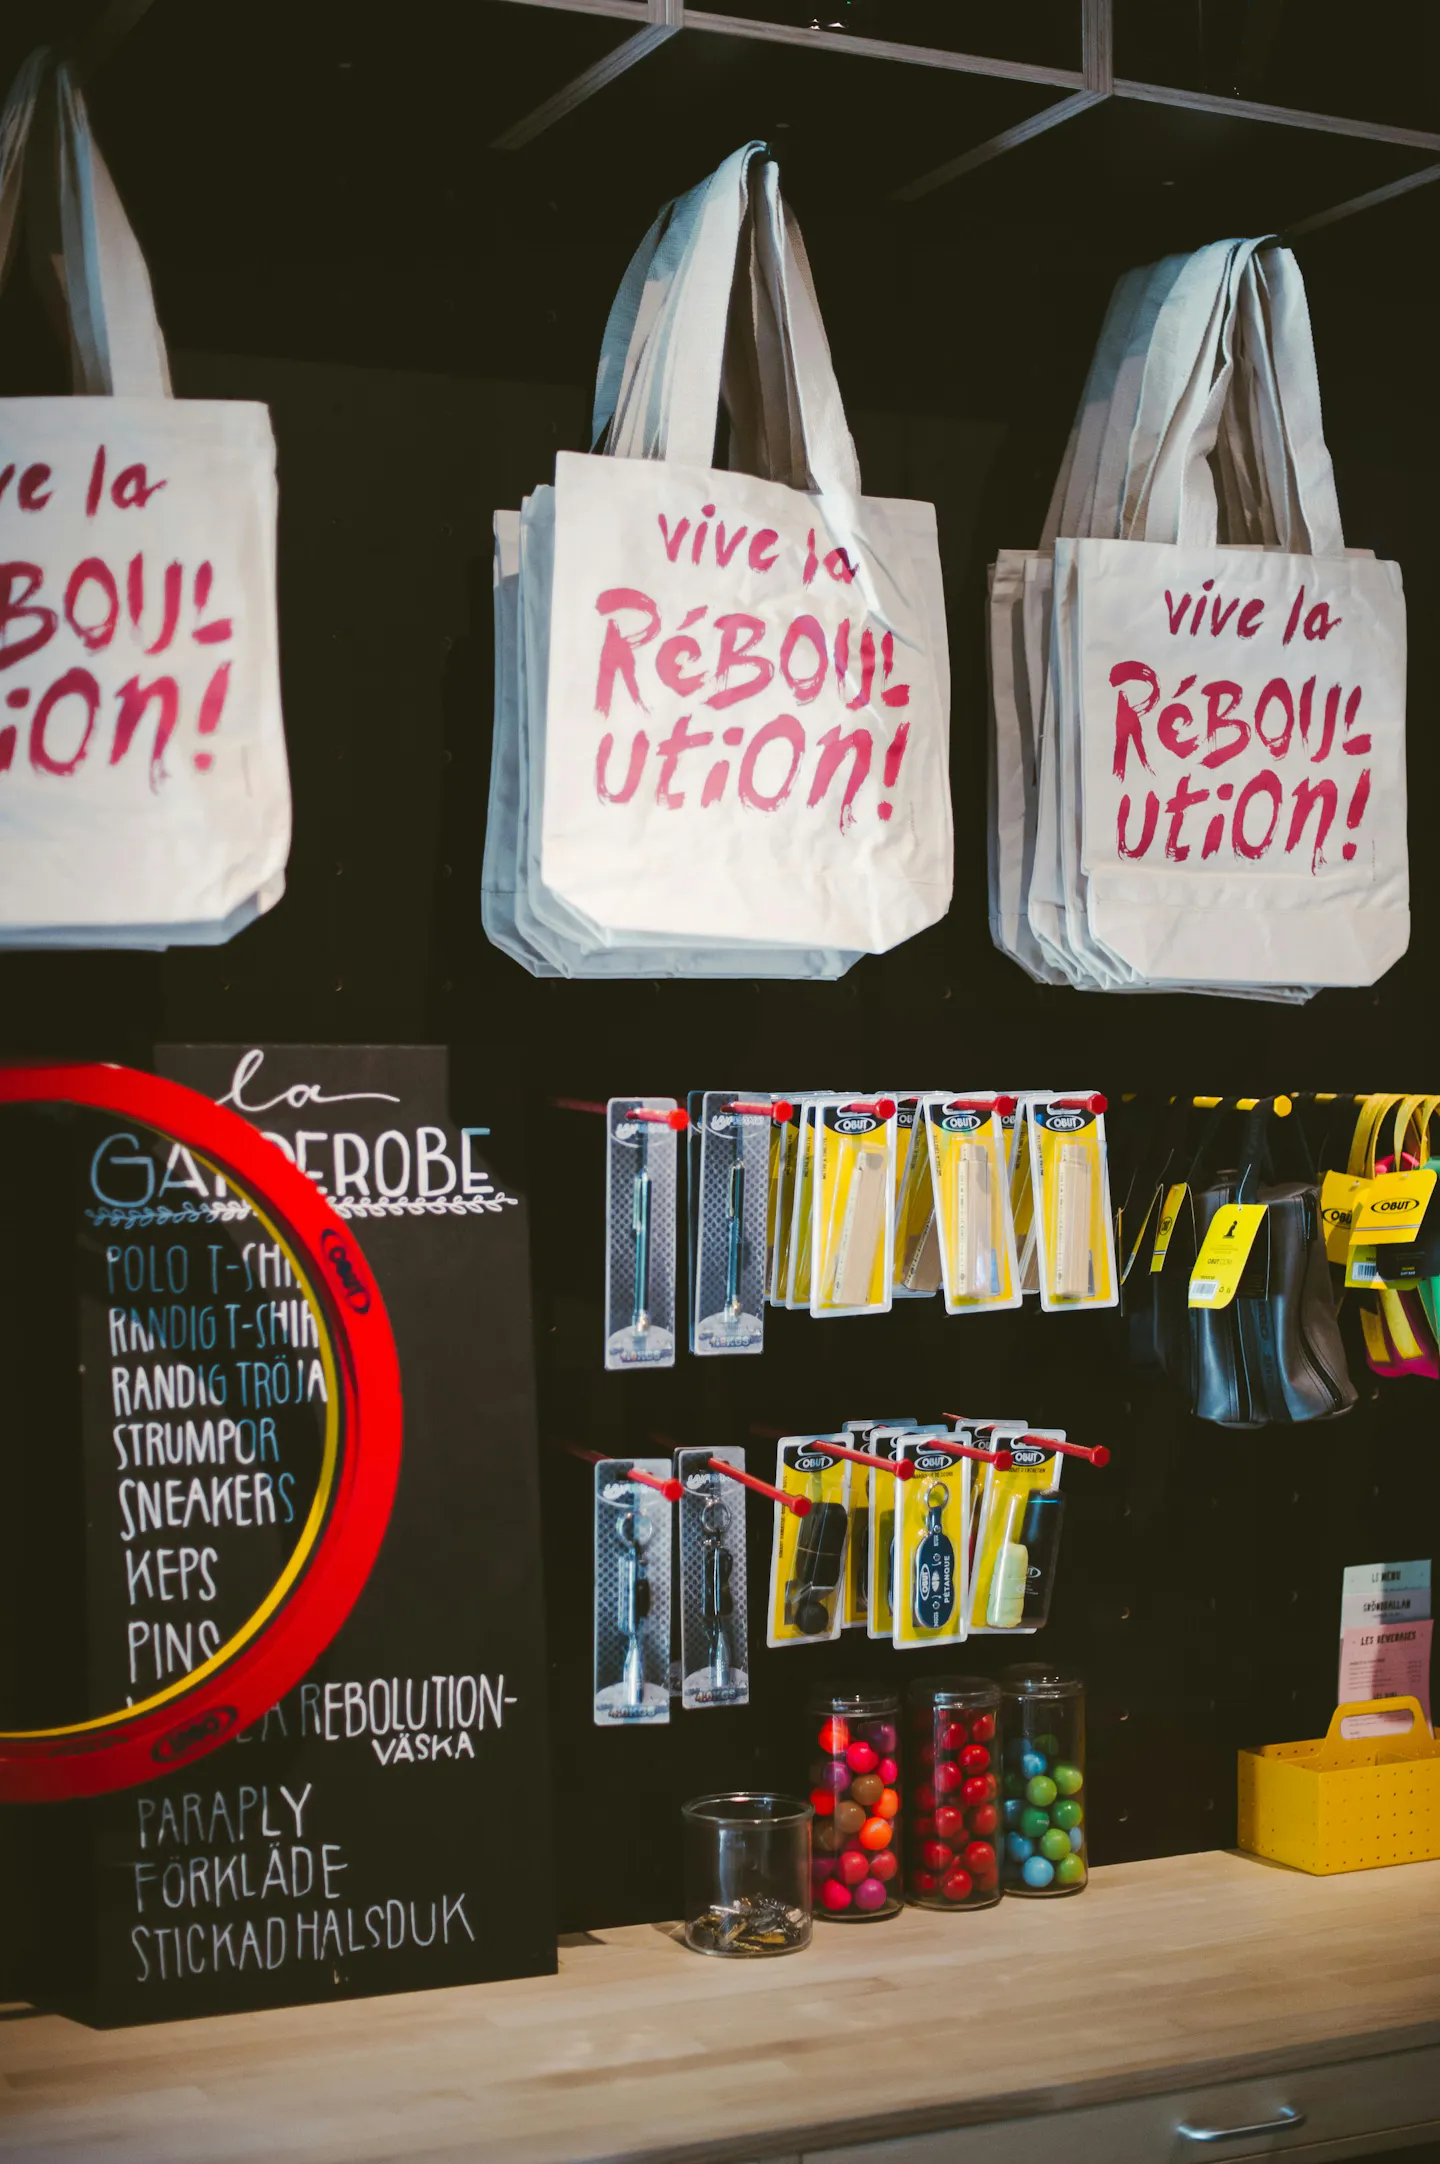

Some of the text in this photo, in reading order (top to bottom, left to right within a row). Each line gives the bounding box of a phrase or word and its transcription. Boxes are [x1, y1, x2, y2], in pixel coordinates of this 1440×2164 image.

[85, 444, 168, 519] la
[657, 503, 860, 589] vive la
[1164, 578, 1342, 647] vive la
[215, 1049, 400, 1113] la
[842, 1119, 868, 1131] OBUT
[949, 1116, 974, 1129] OBUT
[1053, 1116, 1079, 1129] OBUT
[90, 1126, 495, 1209] GAEROBE
[1330, 1210, 1352, 1225] OBU
[1380, 1200, 1411, 1211] OBUT
[107, 1242, 302, 1295] POLO T-SHI
[108, 1299, 319, 1356] RANDIG T-SHIR
[111, 1354, 328, 1416] RANDIG TRÖJA
[113, 1416, 279, 1470] STRUMPOR
[802, 1457, 826, 1469] OBUT
[921, 1456, 945, 1468] OBUT
[1014, 1452, 1039, 1463] OBUT
[118, 1472, 295, 1541] SNEAKERS
[125, 1546, 218, 1605] KEPS
[921, 1571, 929, 1594] OBUT
[127, 1619, 220, 1683] PINS
[372, 1730, 475, 1766] VÄSKA
[138, 1782, 312, 1849] PARAPLY
[134, 1842, 348, 1913] FÖRKLÄDE
[131, 1892, 475, 1982] STICKAD HALSDUK
